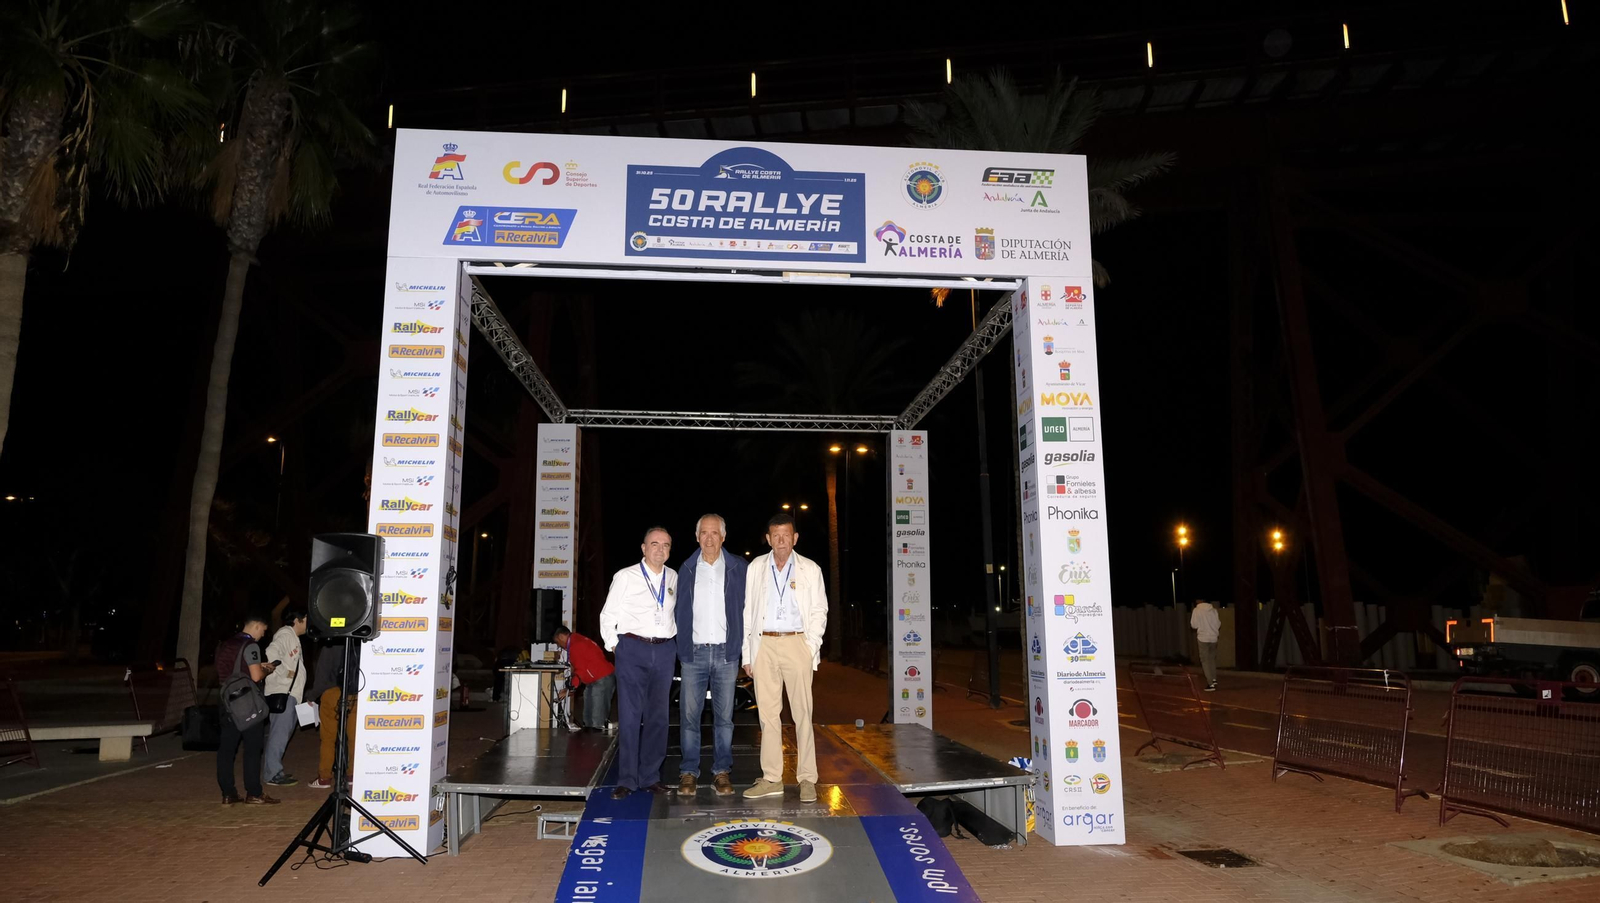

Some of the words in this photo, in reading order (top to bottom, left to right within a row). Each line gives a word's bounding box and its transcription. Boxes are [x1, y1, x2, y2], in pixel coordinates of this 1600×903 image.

[649, 188, 695, 210] 50
[698, 190, 844, 215] RALLYE
[494, 212, 560, 225] CERA
[648, 215, 715, 228] COSTA
[719, 217, 746, 229] DE
[750, 218, 840, 232] ALMERÍA
[506, 232, 548, 243] Recalvi
[910, 234, 945, 244] COSTA
[948, 236, 961, 244] DE
[1001, 238, 1071, 250] DIPUTACIÓN
[899, 245, 962, 258] ALMERÍA
[1001, 250, 1016, 259] DE
[1020, 250, 1069, 261] ALMERÍA
[394, 322, 444, 333] Rallycar
[400, 348, 433, 356] Recalvi
[1041, 392, 1093, 406] MOYA
[388, 410, 439, 422] Rallycar
[394, 436, 428, 444] Recalvi
[1044, 450, 1095, 465] gasolia
[382, 500, 433, 511] Rallycar
[1048, 506, 1098, 520] Phonika
[387, 526, 423, 534] Recalvi
[896, 529, 925, 537] gasolia
[897, 560, 925, 568] Phonika
[382, 620, 417, 628] Recalvi
[251, 651, 258, 660] 3
[370, 690, 423, 702] Rallycar
[376, 718, 412, 726] Recalvi
[364, 790, 418, 802] Rallycar
[1063, 813, 1114, 834] argar
[694, 823, 777, 844] AUTOMOVIL
[787, 827, 820, 842] CLUB
[720, 867, 802, 876] ALMERIA
